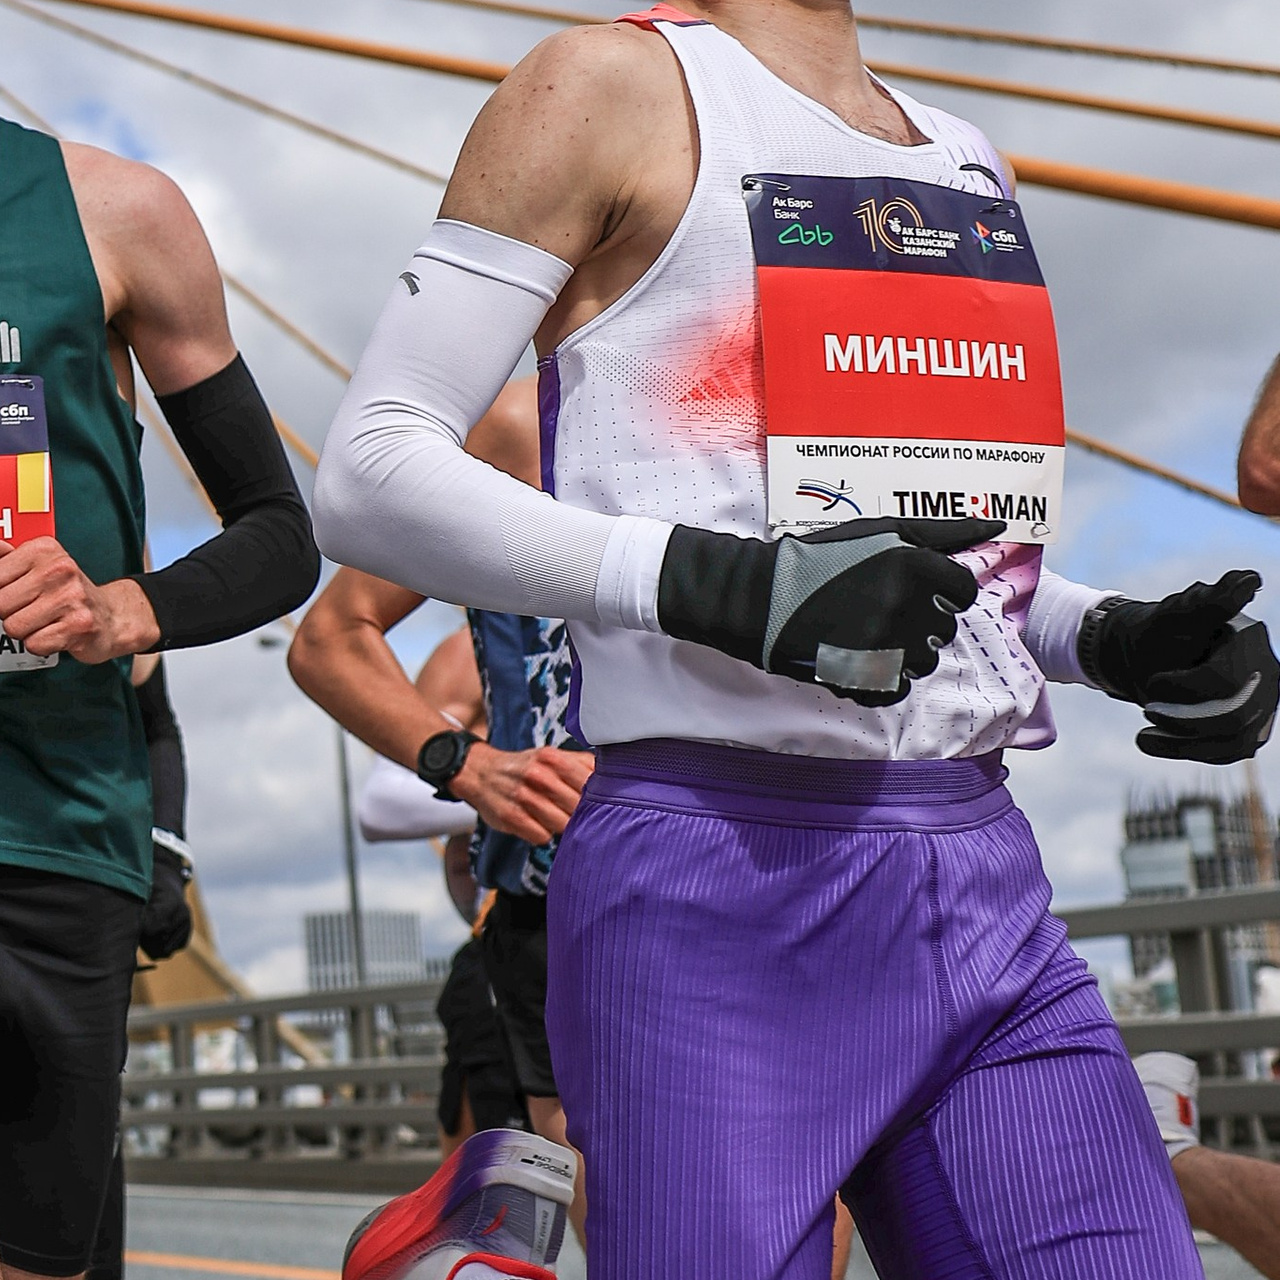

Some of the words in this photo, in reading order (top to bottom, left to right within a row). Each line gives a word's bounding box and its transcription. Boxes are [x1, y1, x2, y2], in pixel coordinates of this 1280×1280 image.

[772, 197, 787, 207] Ак
[787, 198, 813, 209] Барс
[774, 209, 800, 220] Банк
[901, 227, 915, 236] АК
[915, 228, 938, 238] БАРС
[938, 230, 961, 241] БАНК
[902, 237, 956, 249] КАЗАНСКИЙ
[903, 246, 948, 258] МАРАФОН
[823, 333, 1027, 381] МИНШИН
[796, 444, 889, 458] ЧЕМПИОНАТ
[893, 446, 950, 459] РОССИИ
[953, 447, 973, 460] ПО
[976, 451, 1045, 464] МАРАФОНУ
